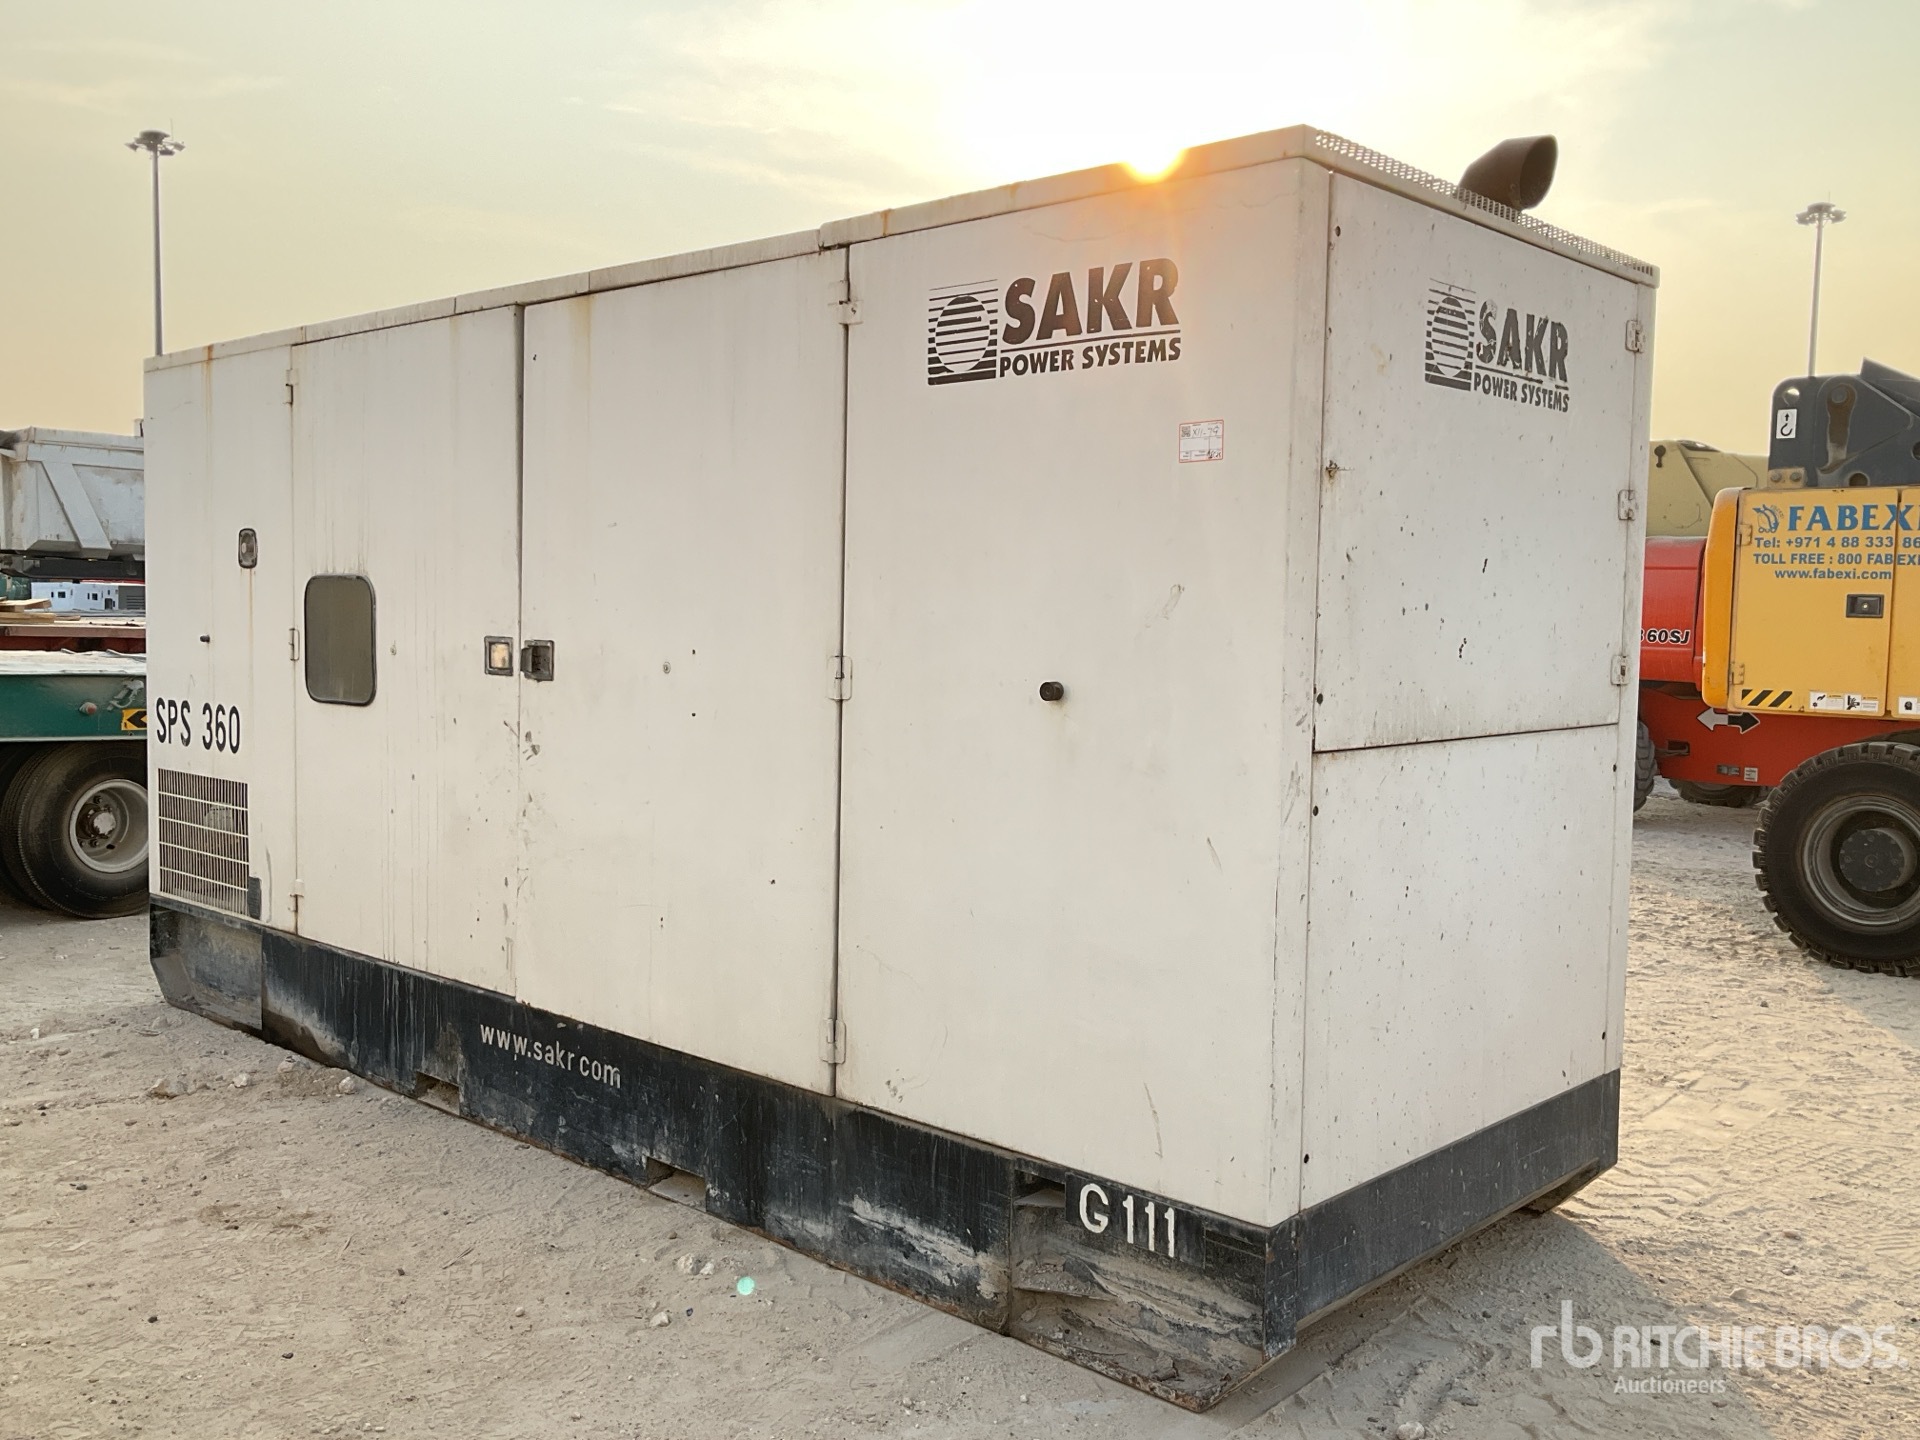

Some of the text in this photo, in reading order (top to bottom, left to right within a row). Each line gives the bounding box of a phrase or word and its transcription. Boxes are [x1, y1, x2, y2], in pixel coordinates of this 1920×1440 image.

[1002, 257, 1180, 345] SAKR
[999, 337, 1182, 378] POWER SYSTEMS
[1475, 299, 1569, 383] SAKR
[1473, 372, 1570, 413] POWER SYSTEMS
[1753, 553, 1786, 565] TOLL
[1790, 553, 1825, 565] FREE
[1837, 553, 1862, 565] 800
[1754, 536, 1781, 549] Tel:
[1786, 536, 1821, 549] +971
[1826, 536, 1836, 548] 4
[1841, 536, 1860, 548] 88
[1865, 536, 1894, 548] 333
[1774, 567, 1892, 580] www.fabexi.com
[156, 697, 240, 755] SPS 360
[1079, 1182, 1176, 1259] G 111
